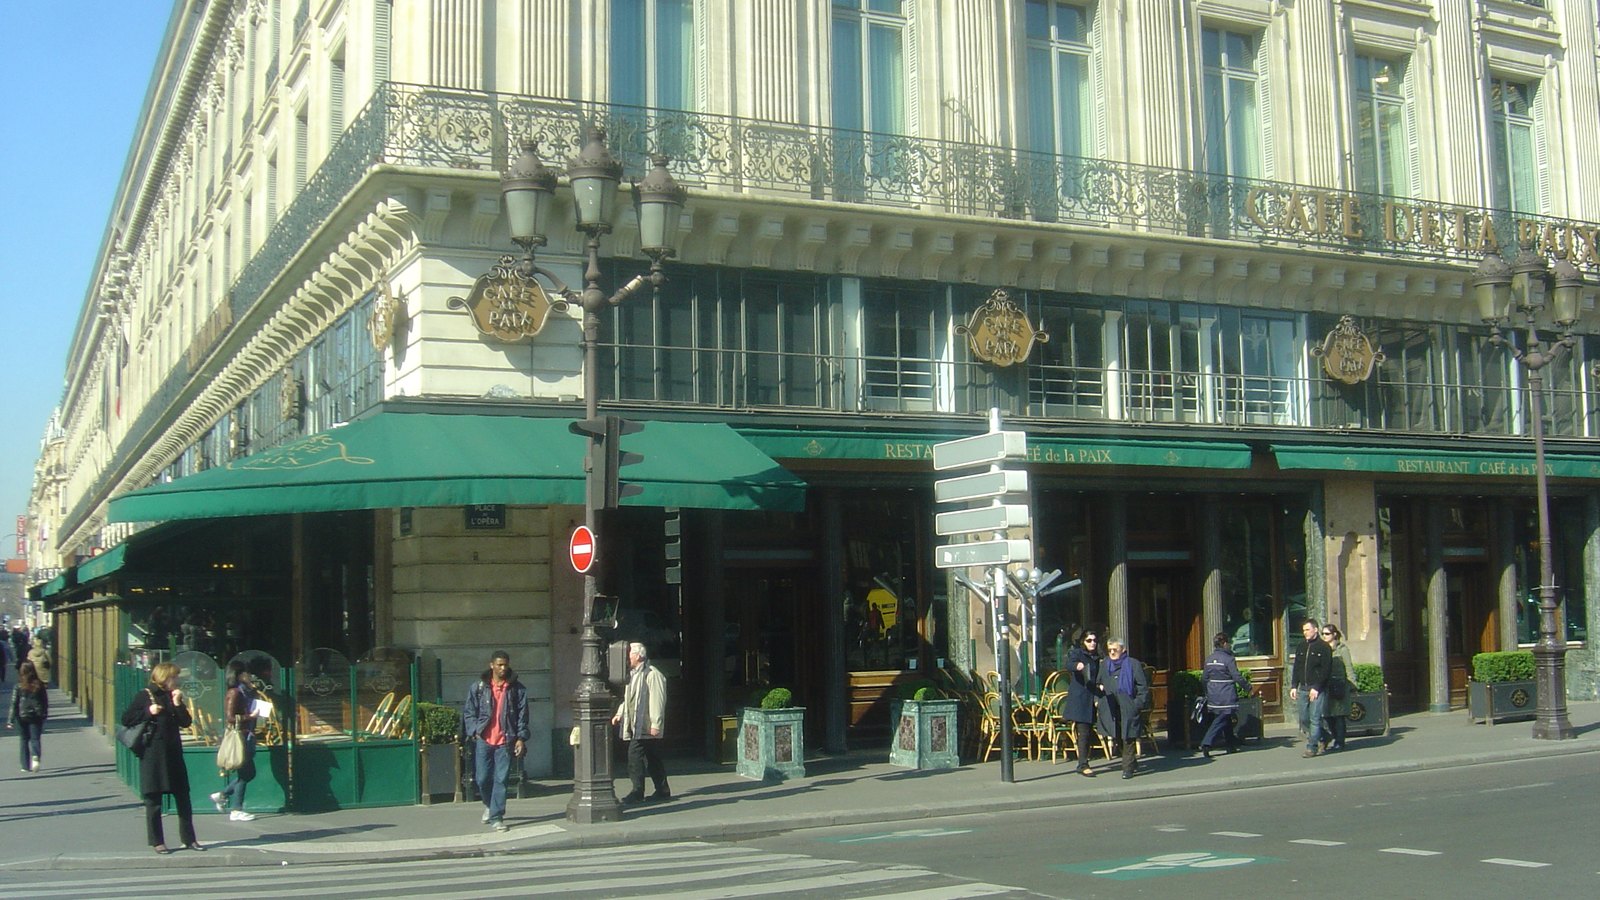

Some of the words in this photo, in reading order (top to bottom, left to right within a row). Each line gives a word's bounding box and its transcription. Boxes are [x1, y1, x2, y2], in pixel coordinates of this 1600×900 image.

[1453, 210, 1498, 252] LA
[1045, 448, 1060, 462] de
[1064, 449, 1075, 463] la
[1079, 450, 1112, 463] PAIX
[1398, 460, 1470, 473] RESTAURANT
[1480, 460, 1505, 475] CAFÉ
[1508, 463, 1519, 475] de
[1521, 464, 1529, 475] la
